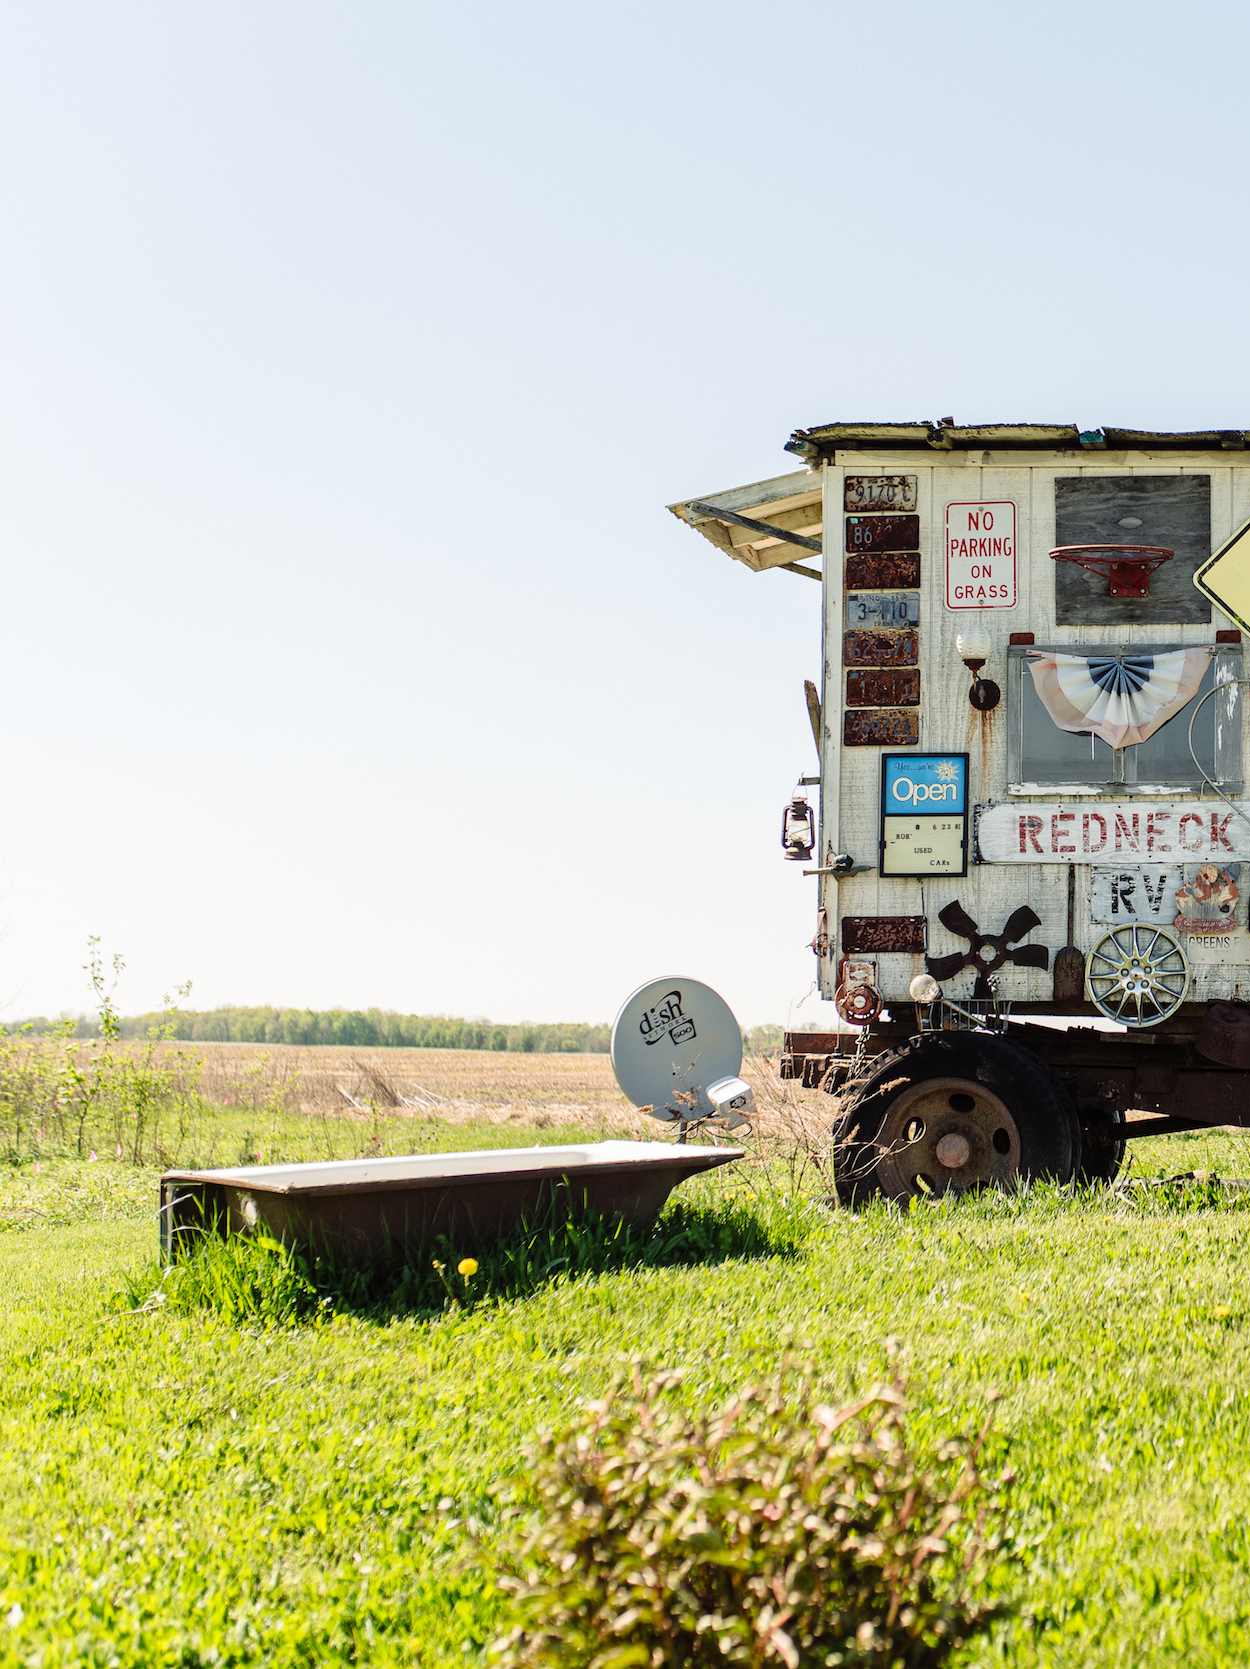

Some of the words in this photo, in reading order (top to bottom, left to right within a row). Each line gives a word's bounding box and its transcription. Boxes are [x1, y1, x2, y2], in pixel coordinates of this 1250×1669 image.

[968, 511, 994, 531] NO
[951, 537, 1012, 558] PARKING
[971, 565, 992, 579] ON
[954, 584, 1008, 599] GRASS
[892, 775, 957, 806] Open
[1018, 812, 1234, 853] REDNECK
[1111, 873, 1167, 915] RV
[640, 1000, 684, 1035] dish
